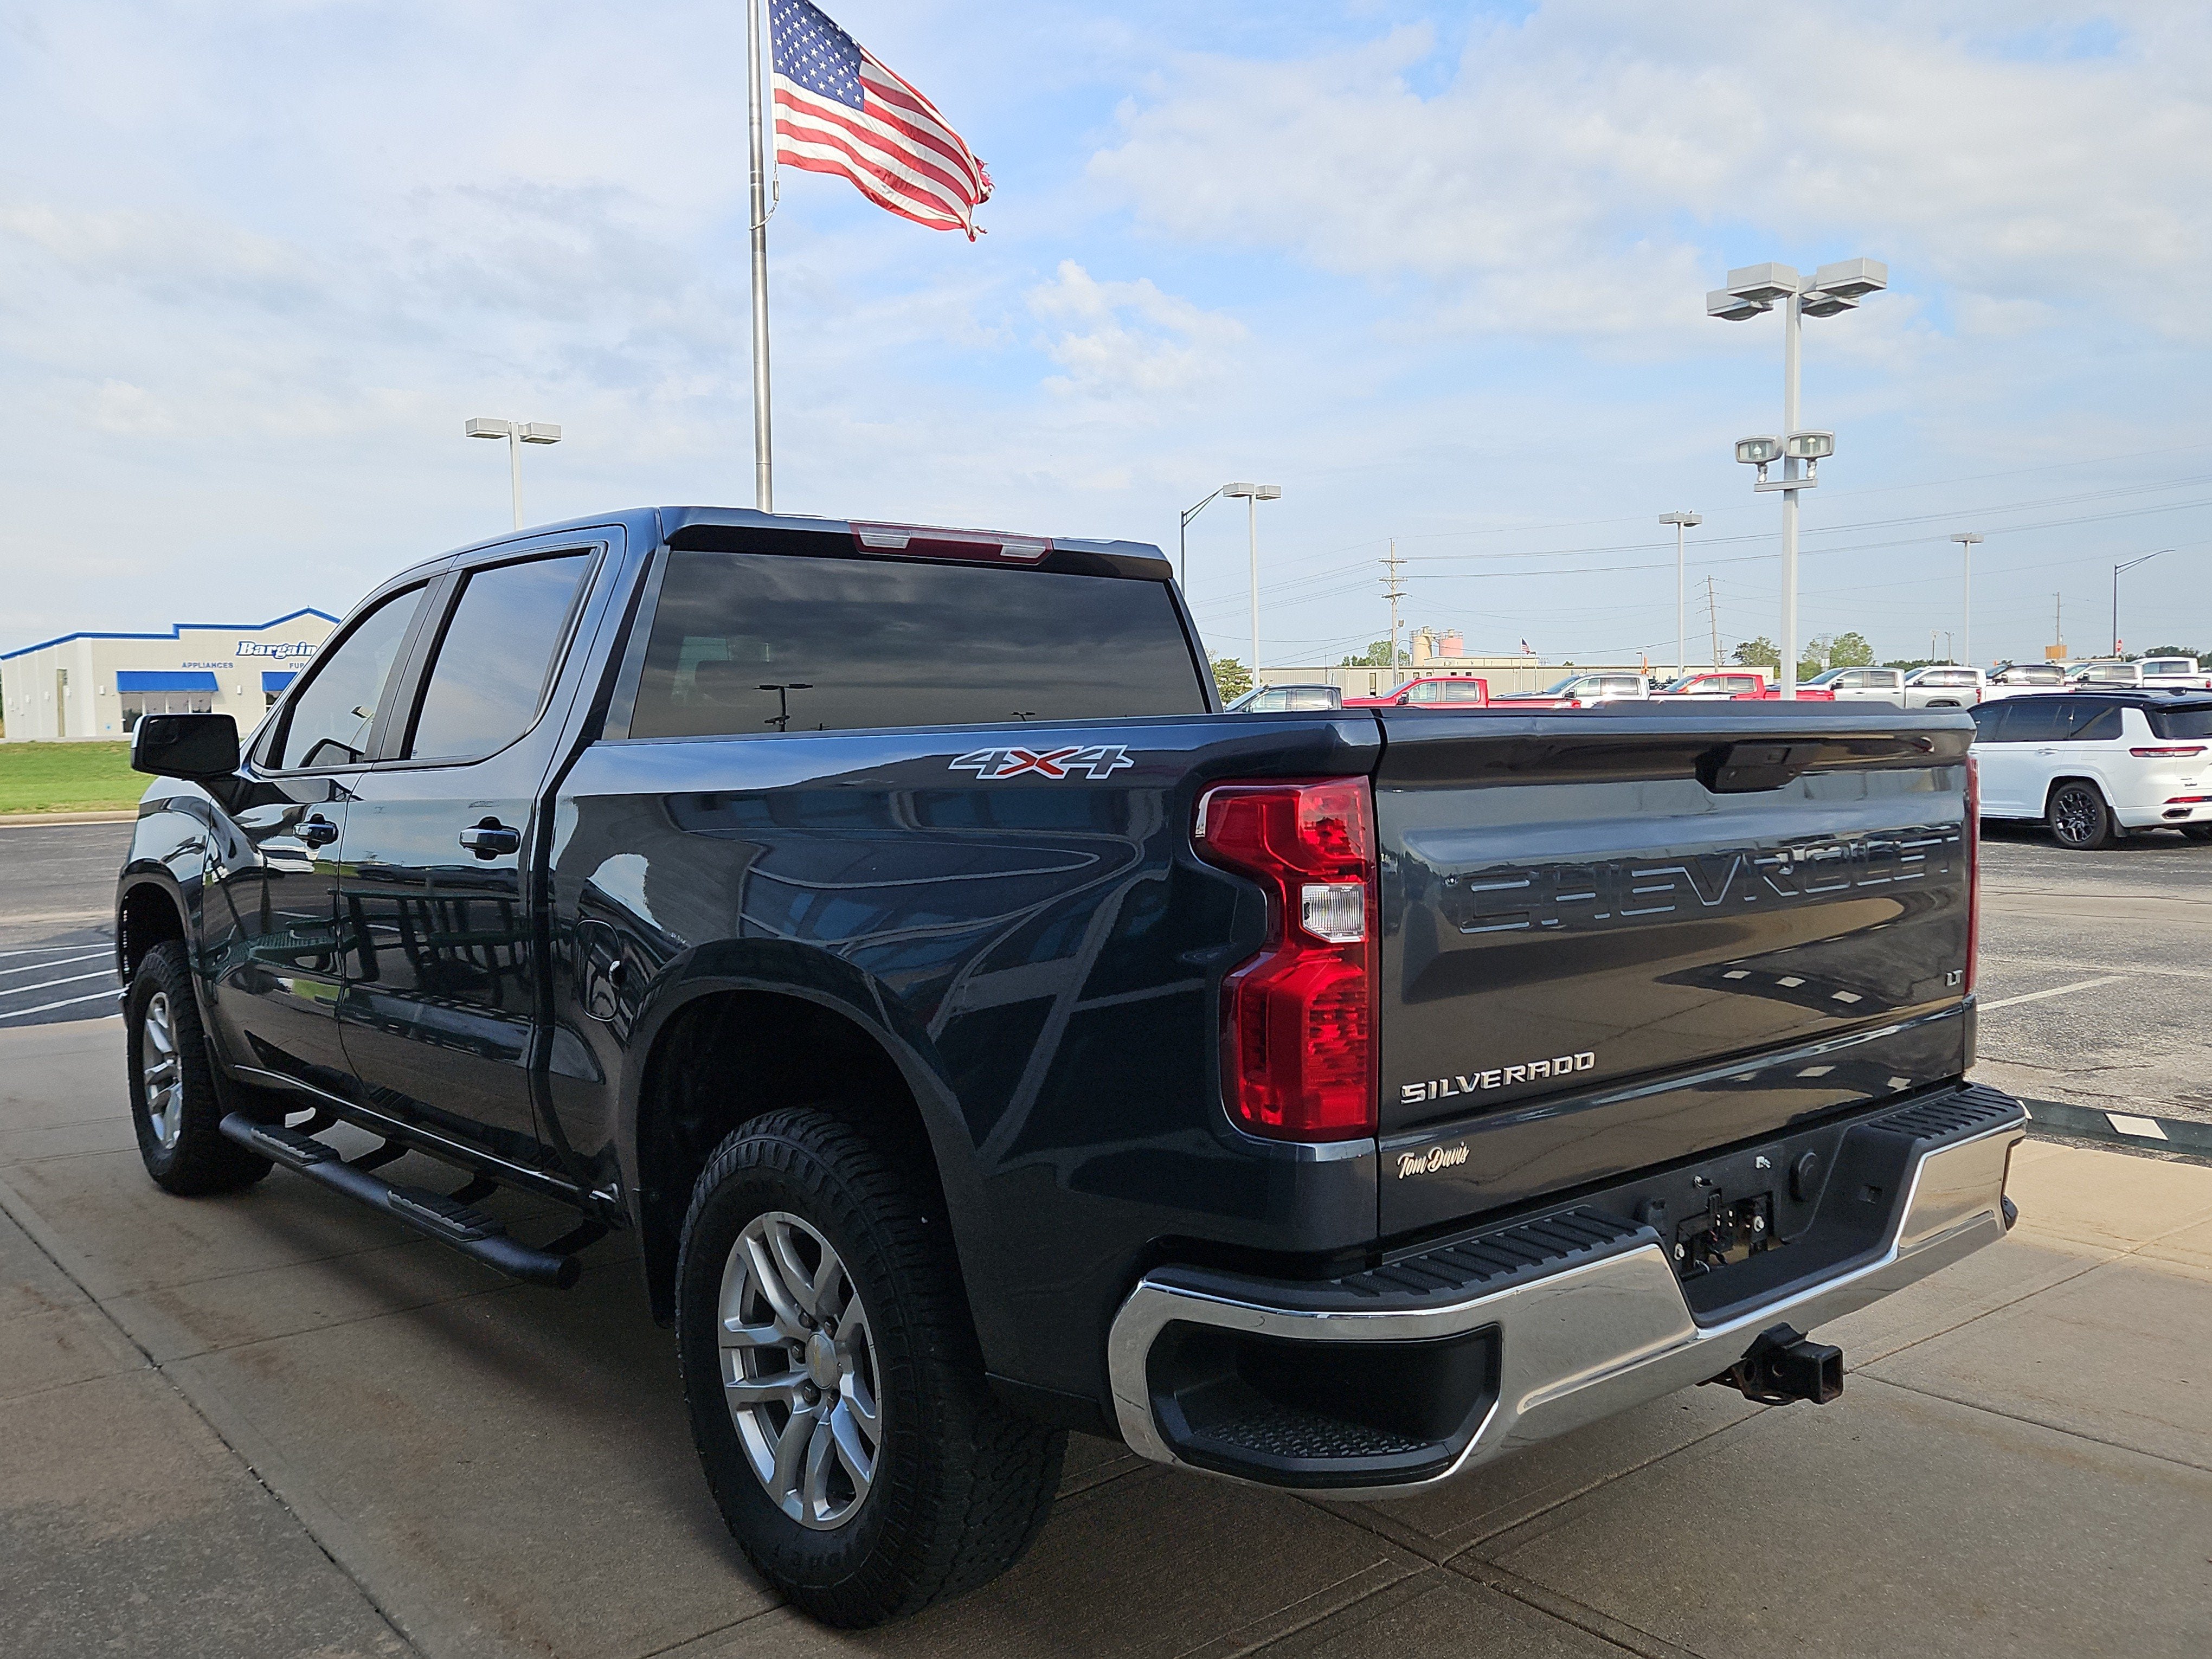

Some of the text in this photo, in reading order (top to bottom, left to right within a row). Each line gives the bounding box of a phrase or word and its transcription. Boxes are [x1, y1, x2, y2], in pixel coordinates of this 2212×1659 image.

[236, 641, 318, 659] Bargain
[1459, 826, 1961, 934] CHEVROLET
[1946, 969, 1963, 986] LT
[1400, 1051, 1595, 1105] SILVERADO
[1397, 1141, 1470, 1180] Tom Davis
